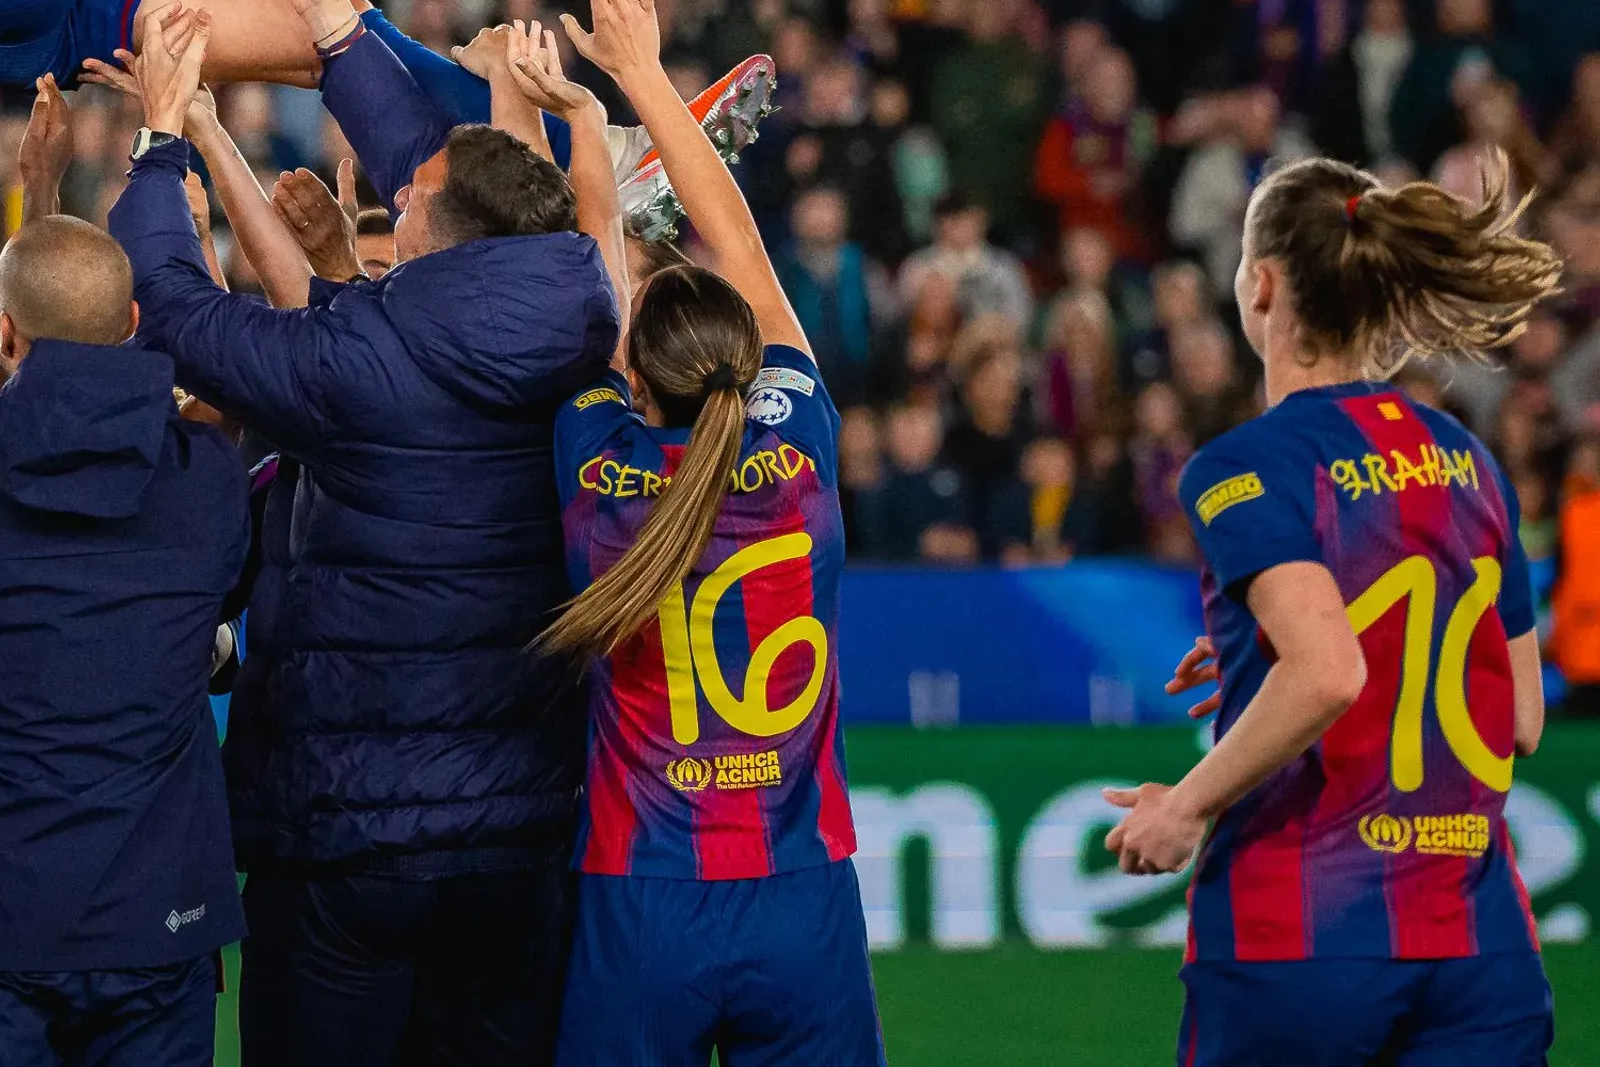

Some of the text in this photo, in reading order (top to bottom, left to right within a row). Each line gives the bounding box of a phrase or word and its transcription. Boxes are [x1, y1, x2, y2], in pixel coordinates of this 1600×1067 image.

[658, 531, 828, 745] 16
[715, 750, 779, 769] UNHCR
[715, 765, 782, 784] ACNUR
[1414, 814, 1489, 833] UNHCR
[1415, 831, 1490, 850] ACNUR
